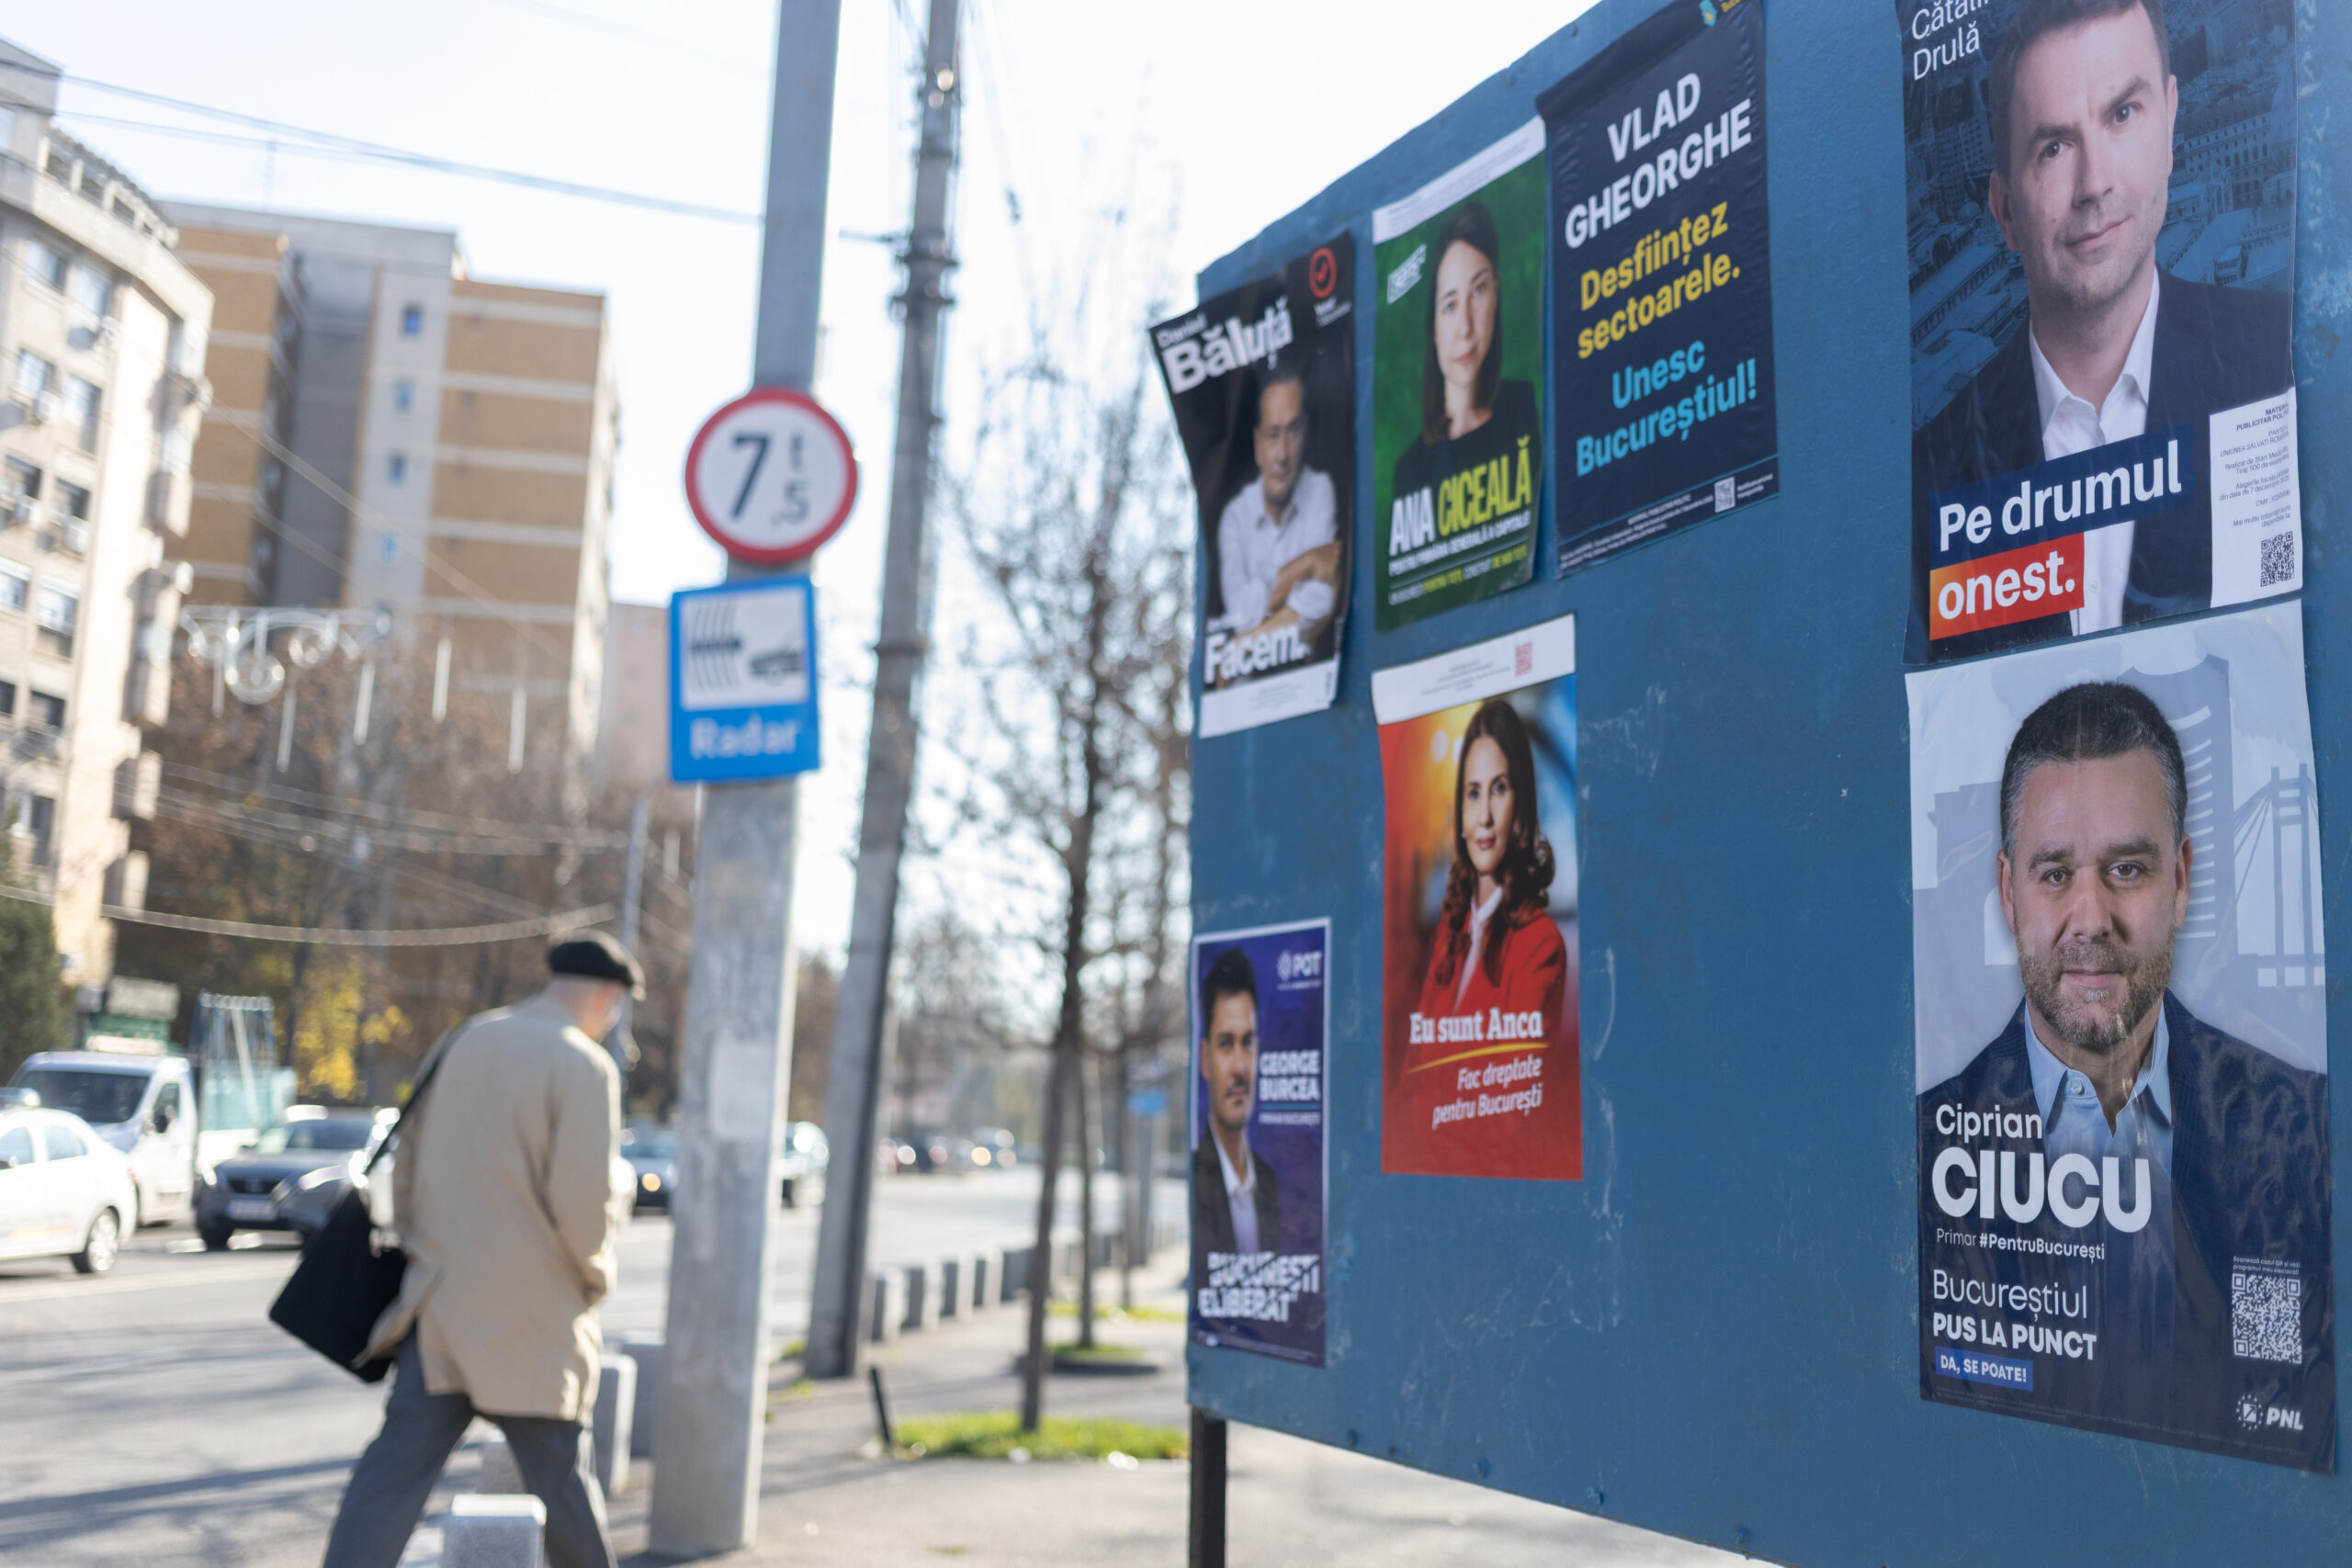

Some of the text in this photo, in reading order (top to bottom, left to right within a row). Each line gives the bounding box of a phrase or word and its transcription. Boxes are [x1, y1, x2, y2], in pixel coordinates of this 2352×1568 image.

[1914, 20, 1980, 81] Drulă
[1607, 73, 1701, 163] VLAD
[1565, 98, 1751, 249] GHEORGHE
[1581, 201, 1728, 311] Desființez
[1577, 253, 1740, 359] sectoarele.
[1611, 341, 1706, 409] Unesc
[1577, 358, 1757, 479] Bucureștiul!
[2236, 416, 2271, 432] PUBLICITAR
[1388, 486, 1435, 557] ANA
[1939, 439, 2182, 552] Pe drumul
[1938, 551, 2075, 620] onest.
[1204, 625, 1312, 684] Facem.
[689, 714, 802, 761] Radar
[1409, 1008, 1544, 1043] Eu sunt Anca
[1457, 1054, 1543, 1091] Fac dreptate
[1431, 1081, 1544, 1131] pentru București
[1936, 1103, 2042, 1144] Ciprian
[1932, 1146, 2152, 1233] CIUCU
[1937, 1228, 2105, 1263] Primar #PentruBucurești
[1933, 1269, 2086, 1322] Bucureștiul
[1933, 1312, 2097, 1360] PUS LA PUNCT
[1940, 1355, 2027, 1382] DA, SE POATE!
[2266, 1407, 2303, 1430] PNL
